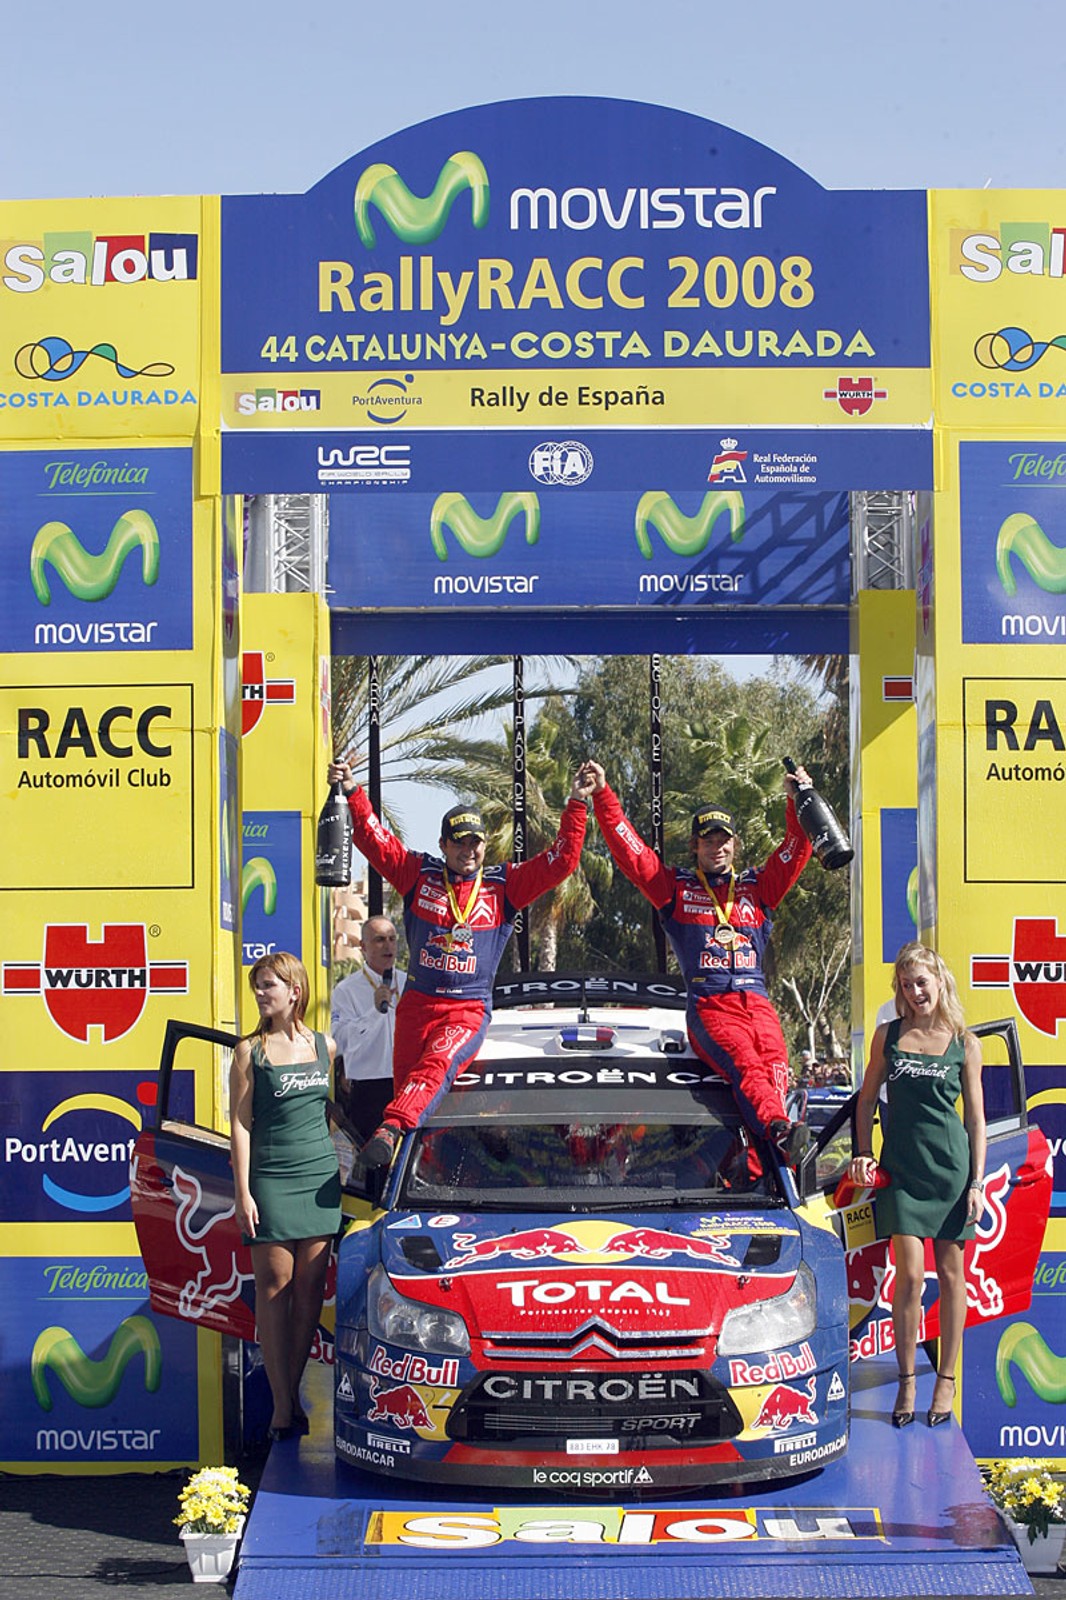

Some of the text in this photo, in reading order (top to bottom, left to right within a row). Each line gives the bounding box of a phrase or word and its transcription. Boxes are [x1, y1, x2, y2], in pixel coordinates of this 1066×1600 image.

[509, 186, 777, 230] movistar
[318, 255, 815, 326] RallyRACC 2008
[260, 334, 299, 363] 44
[664, 329, 876, 359] DAURADA
[77, 389, 198, 407] DAURADA
[351, 394, 423, 406] PortAventura
[470, 385, 666, 412] Rally de España
[951, 382, 1031, 398] COSTA
[317, 445, 411, 466] WRC
[753, 452, 818, 463] Real Federación
[754, 473, 818, 484] Automovilismo
[760, 463, 810, 474] Española de
[434, 574, 539, 595] movistar
[639, 573, 744, 594] movistar
[35, 621, 158, 645] movistar
[17, 705, 173, 759] RACC
[651, 733, 662, 762] DE
[17, 767, 172, 789] Automóvil Club
[651, 771, 662, 854] MURCIA
[420, 949, 477, 973] Red Bull
[701, 951, 756, 968] Red Bull
[46, 967, 147, 988] WÜRTH
[453, 1068, 657, 1086] CITROËN
[846, 1206, 871, 1224] RACC
[496, 1280, 691, 1308] TOTAL
[599, 1308, 640, 1317] depuis
[370, 1346, 459, 1387] Red Bull
[730, 1343, 816, 1386] Red Bull
[483, 1373, 700, 1401] CITROËN
[621, 1415, 702, 1432] SPORT
[36, 1428, 161, 1451] movistar
[367, 1432, 411, 1455] PIRELLI
[774, 1431, 817, 1454] PIRELLI
[335, 1435, 396, 1468] EURODATACAR
[533, 1468, 634, 1487] le coq sportif
